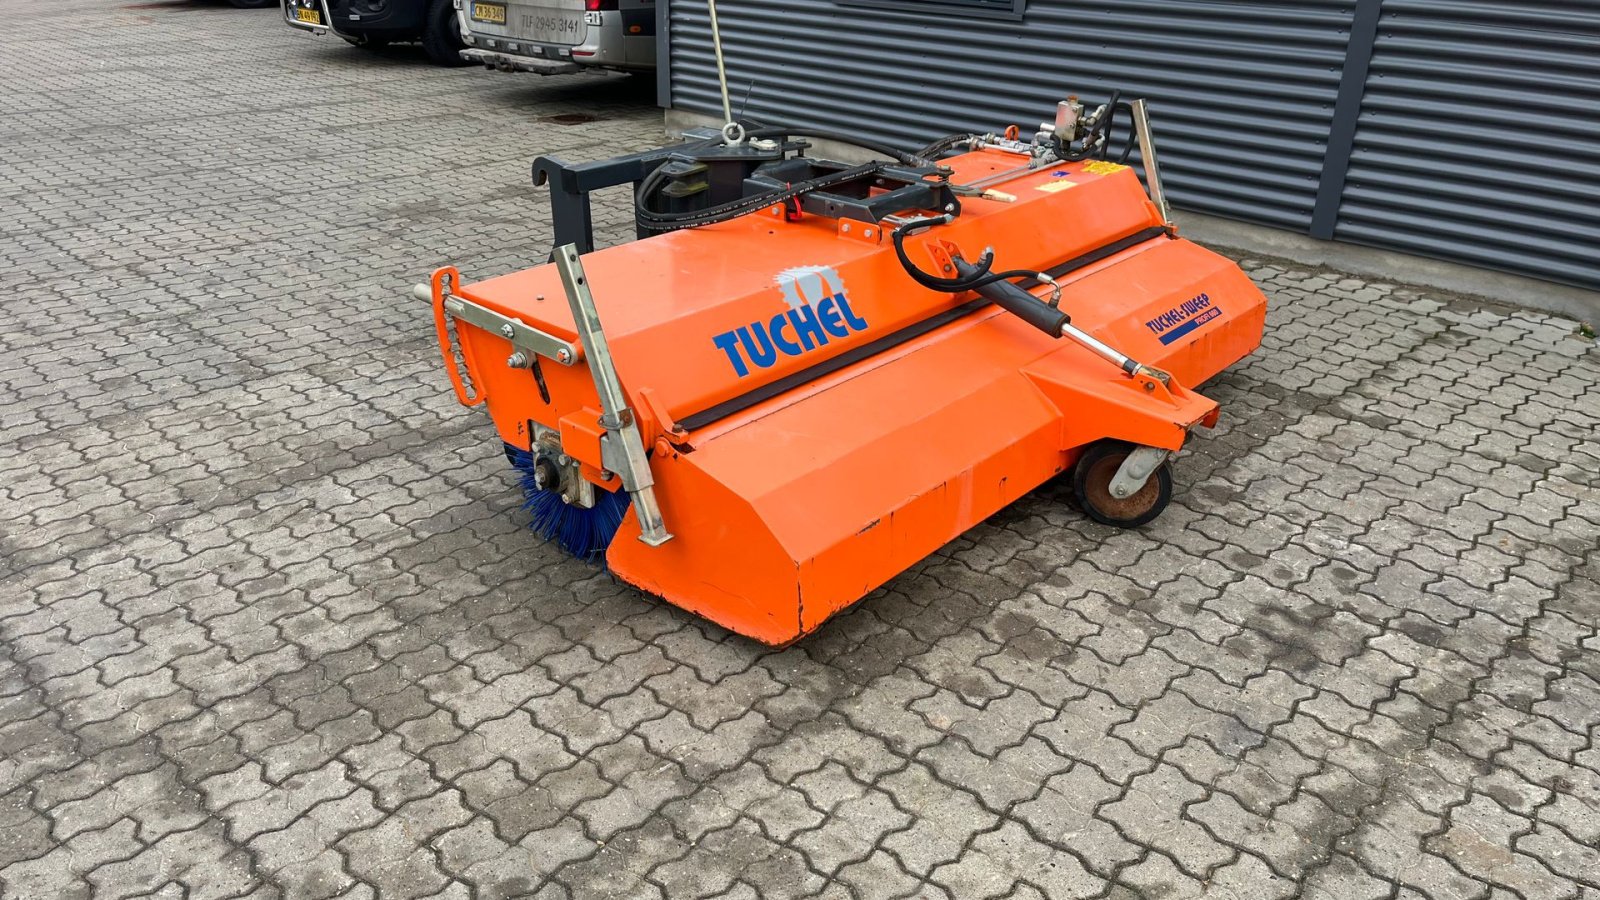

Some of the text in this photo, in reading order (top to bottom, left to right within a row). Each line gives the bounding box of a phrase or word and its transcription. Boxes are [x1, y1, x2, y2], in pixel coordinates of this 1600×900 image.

[484, 6, 491, 18] 36
[521, 15, 578, 33] TLF 2945 3141
[712, 292, 868, 377] TUCHEL
